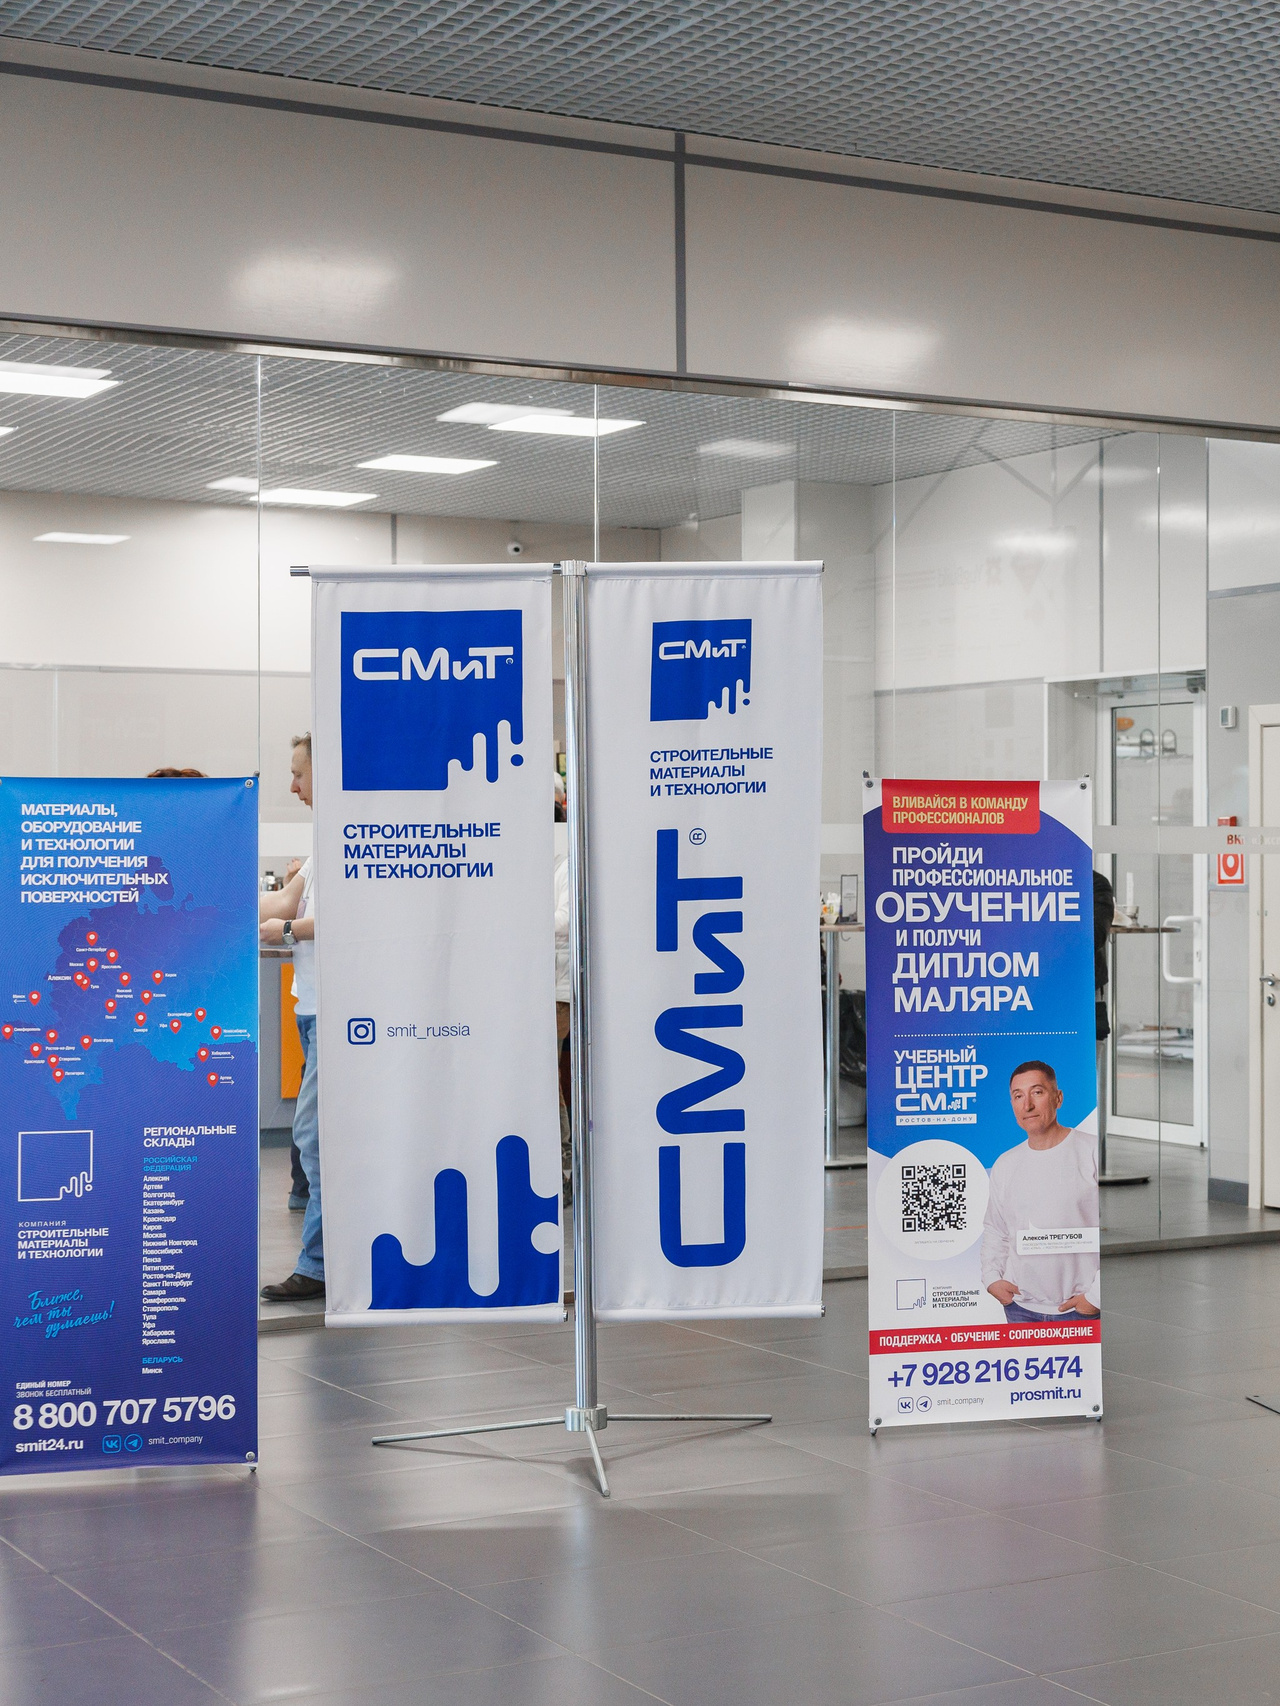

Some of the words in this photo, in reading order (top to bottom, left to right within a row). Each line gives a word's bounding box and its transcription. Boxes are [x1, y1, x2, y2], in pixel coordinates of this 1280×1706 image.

[650, 747, 774, 763] СТРОИТЕЛЬНЫЕ
[650, 765, 746, 780] МАТЕРИАЛЫ
[650, 783, 661, 796] И
[665, 781, 767, 795] ТЕХНОЛОГИИ
[893, 794, 956, 809] ВЛИВАЙСЯ
[960, 797, 967, 809] В
[971, 797, 1029, 811] КОМАНДУ
[21, 803, 118, 818] МАТЕРИАЛЫ,
[893, 812, 1005, 824] ПРОФЕССИОНАЛОВ
[21, 821, 142, 835] ОБОРУДОВАНИЕ
[343, 822, 501, 840] СТРОИТЕЛЬНЫЕ
[21, 839, 32, 850] И
[35, 838, 135, 850] ТЕХНОЛОГИИ
[344, 843, 467, 860] МАТЕРИАЛЫ
[893, 843, 983, 867] ПРОЙДИ
[20, 856, 54, 870] ДЛЯ
[57, 856, 148, 868] ПОЛУЧЕНИЯ
[344, 864, 358, 879] И
[365, 862, 494, 879] ТЕХНОЛОГИИ
[21, 873, 169, 886] ИСКЛЮЧИТЕЛЬНЫХ
[893, 869, 1073, 886] ПРОФЕССИОНАЛЬНОЕ
[21, 888, 139, 903] ПОВЕРХНОСТЕЙ
[875, 891, 1081, 923] ОБУЧЕНИЕ
[896, 930, 907, 946] И
[913, 929, 981, 947] ПОЛУЧИ
[893, 952, 1039, 984] ДИПЛОМ
[894, 986, 1034, 1012] МАЛЯРА
[386, 1022, 471, 1040] smit_russia
[894, 1045, 976, 1064] УЧЕБНЫЙ
[896, 1065, 988, 1093] ЦЕНТР
[143, 1125, 237, 1136] РЕГИОНАЛЬНЫЕ
[143, 1137, 195, 1148] СКЛАДЫ
[143, 1155, 198, 1164] РОССИЙСКАЯ
[143, 1164, 192, 1172] ФЕДЕРАЦИЯ
[143, 1183, 163, 1191] Артем
[18, 1220, 67, 1228] КОМПАНИЯ
[17, 1227, 109, 1239] СТРОИТЕЛЬНЫЕ
[1022, 1234, 1048, 1242] Алексей
[1049, 1233, 1083, 1241] ТРЕГУБОВ
[17, 1239, 89, 1249] МАТЕРИАЛЫ
[17, 1251, 26, 1260] И
[28, 1248, 104, 1259] ТЕХНОЛОГИИ
[28, 1289, 84, 1310] Ближе,
[13, 1313, 43, 1328] чем
[47, 1305, 73, 1320] ты
[45, 1300, 115, 1339] думаешь!
[879, 1333, 942, 1347] ПОДДЕРЖКА
[951, 1330, 1000, 1343] ОБУЧЕНИЕ
[1008, 1326, 1093, 1340] СОПРОВОЖДЕНИЕ
[142, 1356, 184, 1364] БЕЛАРУСЬ
[888, 1363, 917, 1388] +7
[922, 1361, 970, 1386] 928
[975, 1358, 1020, 1383] 216
[1024, 1355, 1083, 1380] 5474
[16, 1381, 46, 1390] ЕДИНЫЙ
[47, 1380, 71, 1389] НОМЕР
[16, 1390, 44, 1399] ЗВОНОК
[45, 1387, 92, 1398] БЕСПЛАТНЫЙ
[1010, 1387, 1081, 1405] prosmit.ru
[937, 1396, 985, 1407] smit_company
[12, 1404, 33, 1430] 8
[38, 1401, 97, 1429] 800
[103, 1398, 157, 1426] 707
[162, 1395, 236, 1422] 5796
[15, 1438, 84, 1453] smit24.ru
[148, 1435, 204, 1446] smit_company
